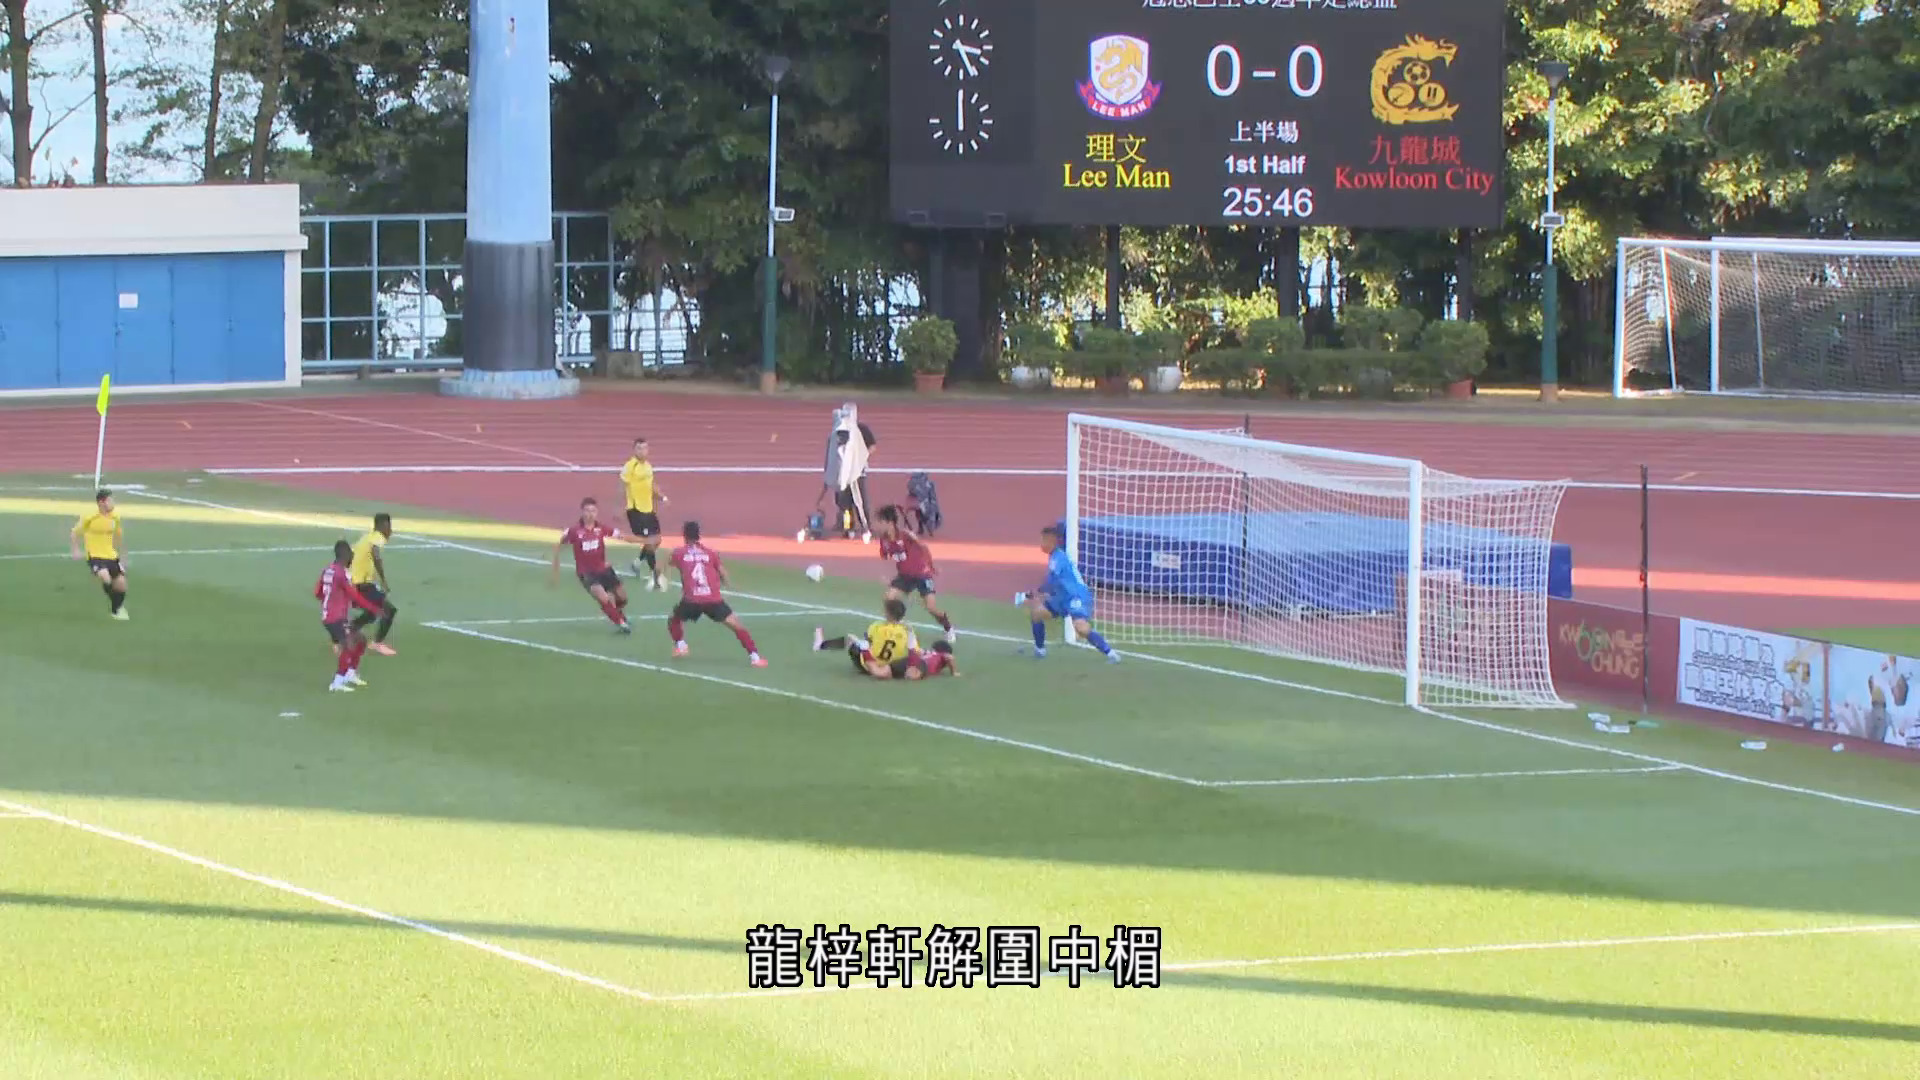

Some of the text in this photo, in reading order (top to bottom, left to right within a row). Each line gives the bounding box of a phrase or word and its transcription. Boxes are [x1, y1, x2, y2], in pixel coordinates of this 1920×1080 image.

[1207, 44, 1242, 97] 0
[1288, 44, 1323, 97] 0
[1230, 120, 1299, 143] 上半場
[1085, 133, 1147, 163] 理文
[1368, 134, 1461, 165] 九龍城
[1063, 163, 1171, 188] Lee Man
[1225, 154, 1307, 174] 1st Half
[1335, 166, 1494, 196] Kowloon City
[1222, 187, 1313, 217] 25:46
[691, 562, 706, 587] 4
[879, 639, 896, 661] 6
